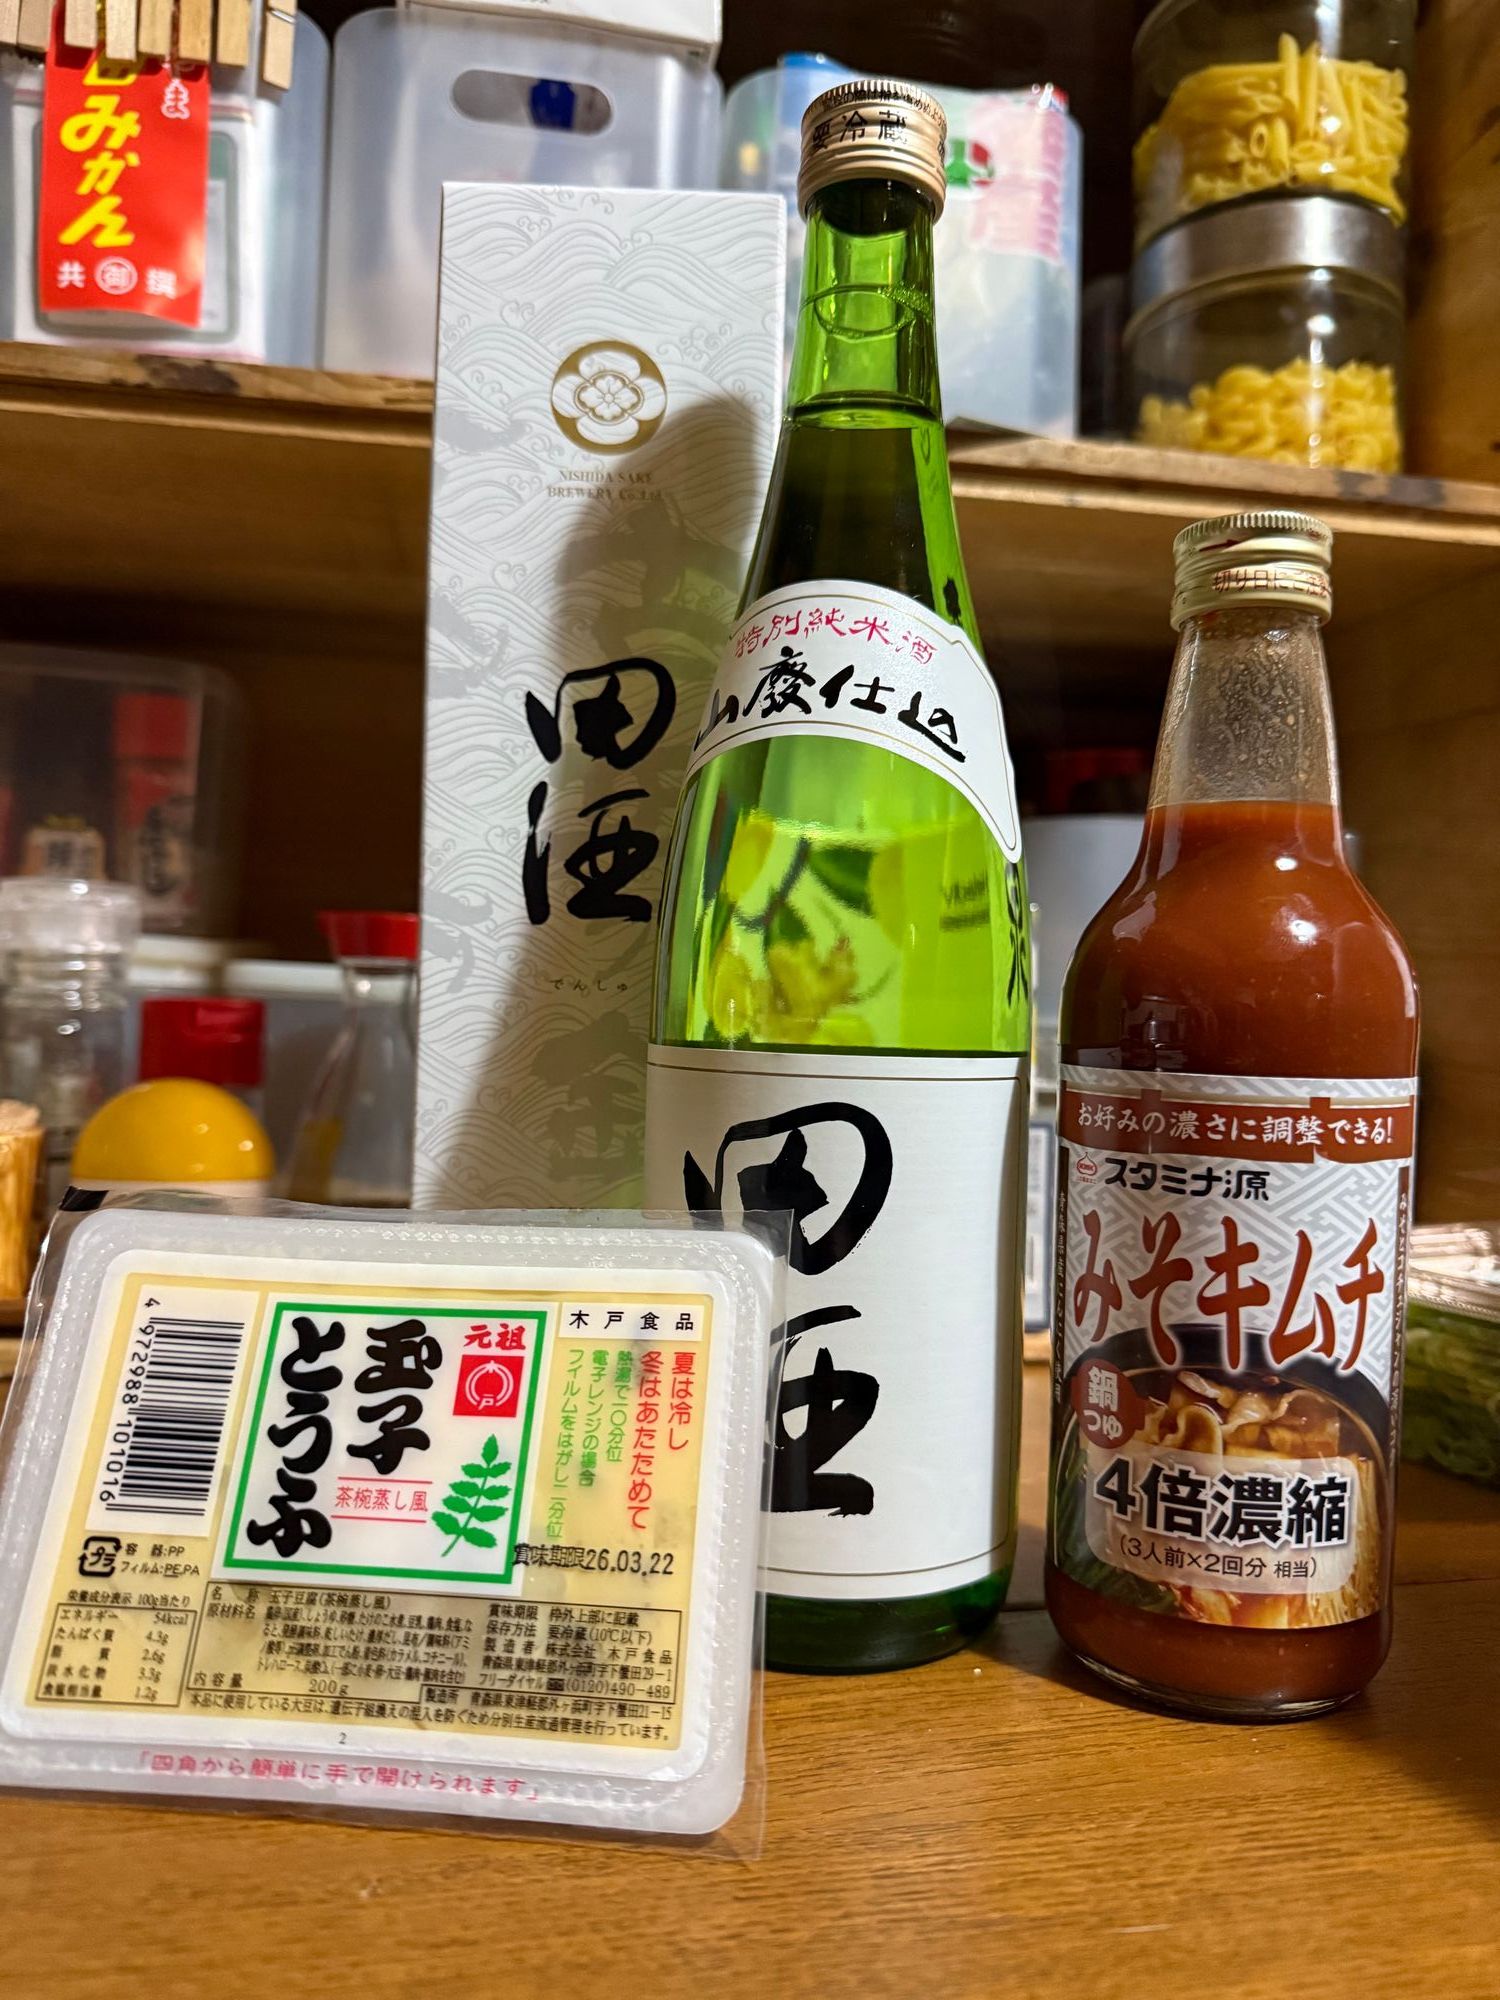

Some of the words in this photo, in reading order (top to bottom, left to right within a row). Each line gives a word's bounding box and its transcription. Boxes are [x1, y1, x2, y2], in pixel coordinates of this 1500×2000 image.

[559, 470, 613, 482] NISHIDA
[736, 606, 939, 665] 特別純米酒
[1077, 1102, 1394, 1146] お好みの濃さに調整できる!
[1104, 1156, 1271, 1201] スタミナ源
[1073, 1209, 1386, 1372] みそキムチ
[463, 1322, 527, 1350] 元祖
[569, 1310, 695, 1331] 木戸食品
[668, 1352, 697, 1451] 夏は冷し
[246, 1316, 346, 1558] とうふ
[627, 1350, 664, 1530] 冬はあたためて
[1095, 1457, 1349, 1546] 4倍濃縮
[88, 1546, 117, 1568] プラ
[486, 1620, 537, 1638] 保存方法
[607, 1646, 673, 1665] 木戸食品
[479, 1672, 545, 1690] フリーダイヤル
[338, 1731, 348, 1745] 2
